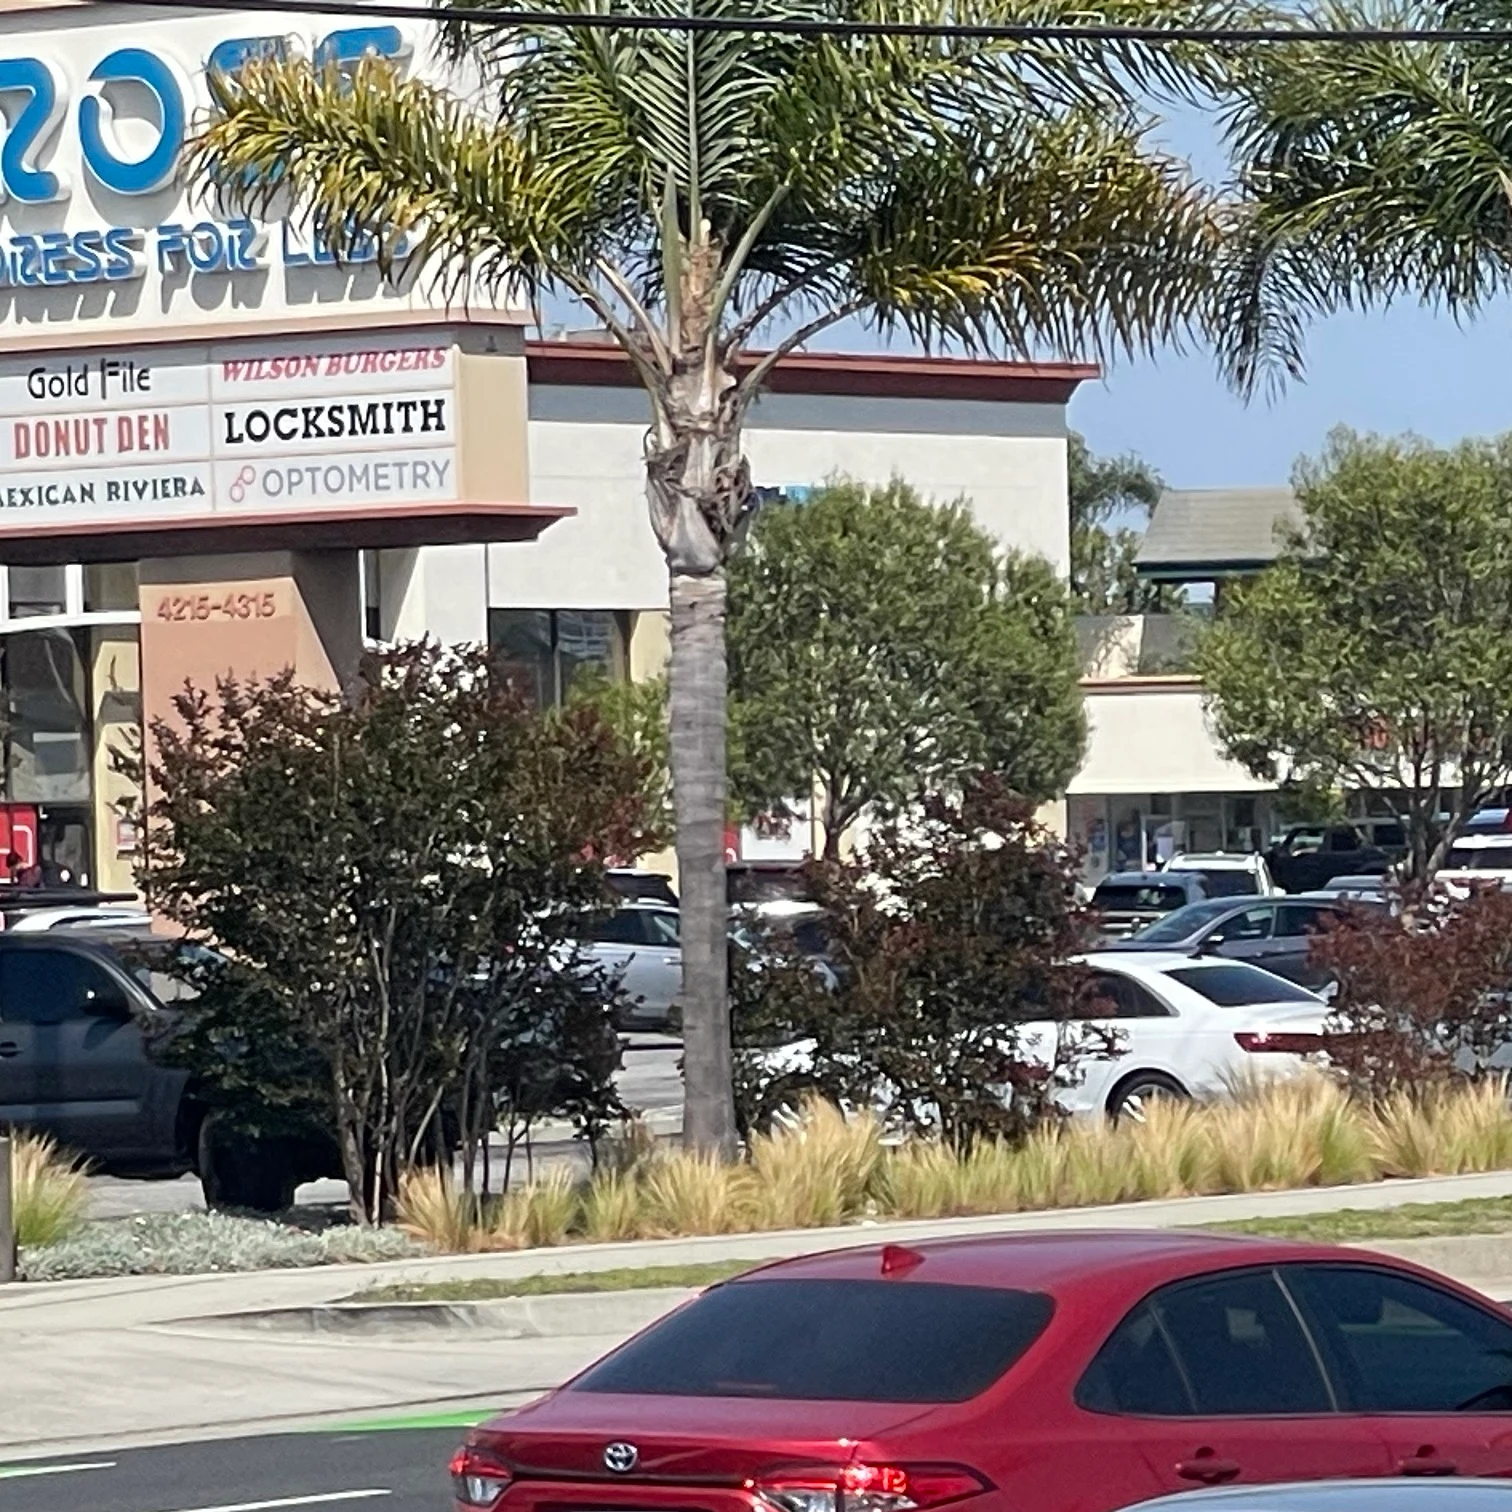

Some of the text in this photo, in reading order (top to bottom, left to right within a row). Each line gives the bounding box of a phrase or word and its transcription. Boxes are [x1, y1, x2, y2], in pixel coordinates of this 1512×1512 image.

[0, 228, 136, 286] RESS
[156, 218, 259, 271] FOR
[27, 357, 152, 400] Gold File
[222, 347, 448, 382] WILSON BURGERS
[14, 413, 171, 459] DONUT DEN
[224, 398, 447, 444] LOCKSMITH
[0, 475, 206, 508] EXICAN RIVIERA
[262, 458, 451, 497] OPTOMETRY
[157, 592, 277, 622] 4215-4315
